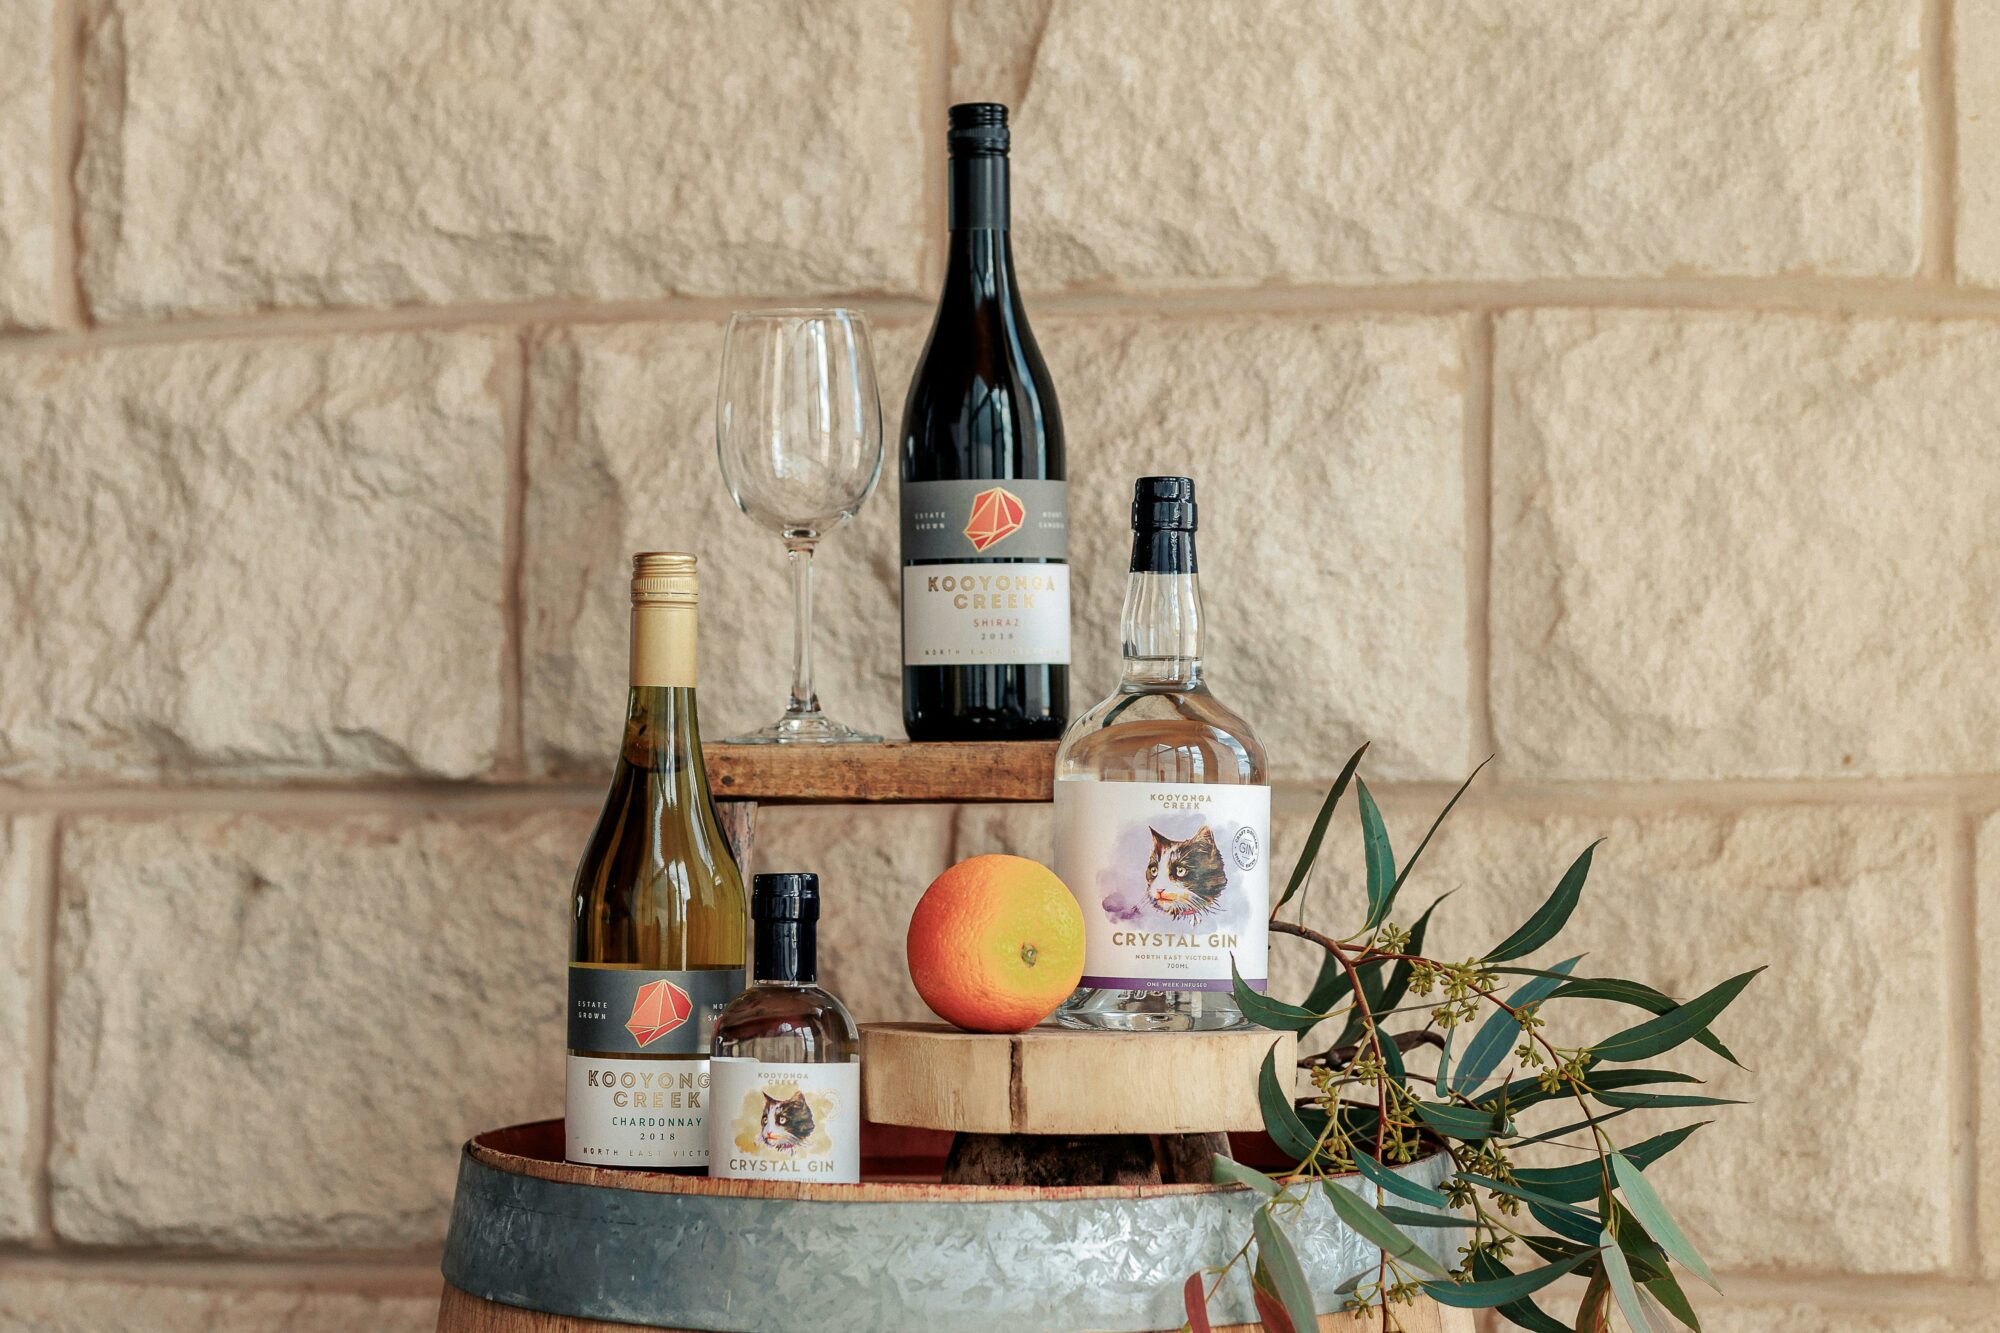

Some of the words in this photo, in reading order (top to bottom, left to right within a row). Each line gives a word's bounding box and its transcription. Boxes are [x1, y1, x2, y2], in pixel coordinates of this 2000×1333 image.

[927, 575, 1055, 593] KOOYONGA
[953, 593, 1035, 610] CREEK
[973, 618, 1019, 628] SHIRAZ
[1150, 793, 1212, 802] KOOYONGA
[1163, 802, 1200, 810] CREEK
[1239, 842, 1254, 856] GIN
[1112, 932, 1200, 948] CRYSTAL
[1208, 934, 1237, 948] GIN
[577, 1000, 608, 1009] ESTATE
[578, 1011, 606, 1020] GROWN
[588, 1069, 711, 1089] KOOYONG
[757, 1072, 809, 1080] KOOYONGA
[613, 1091, 701, 1109] CREEK
[612, 1116, 702, 1127] CHARDONNAY
[640, 1133, 675, 1141] 2018
[583, 1147, 619, 1156] NORTH
[729, 1158, 800, 1173] CRYSTAL
[807, 1160, 834, 1173] GIN
